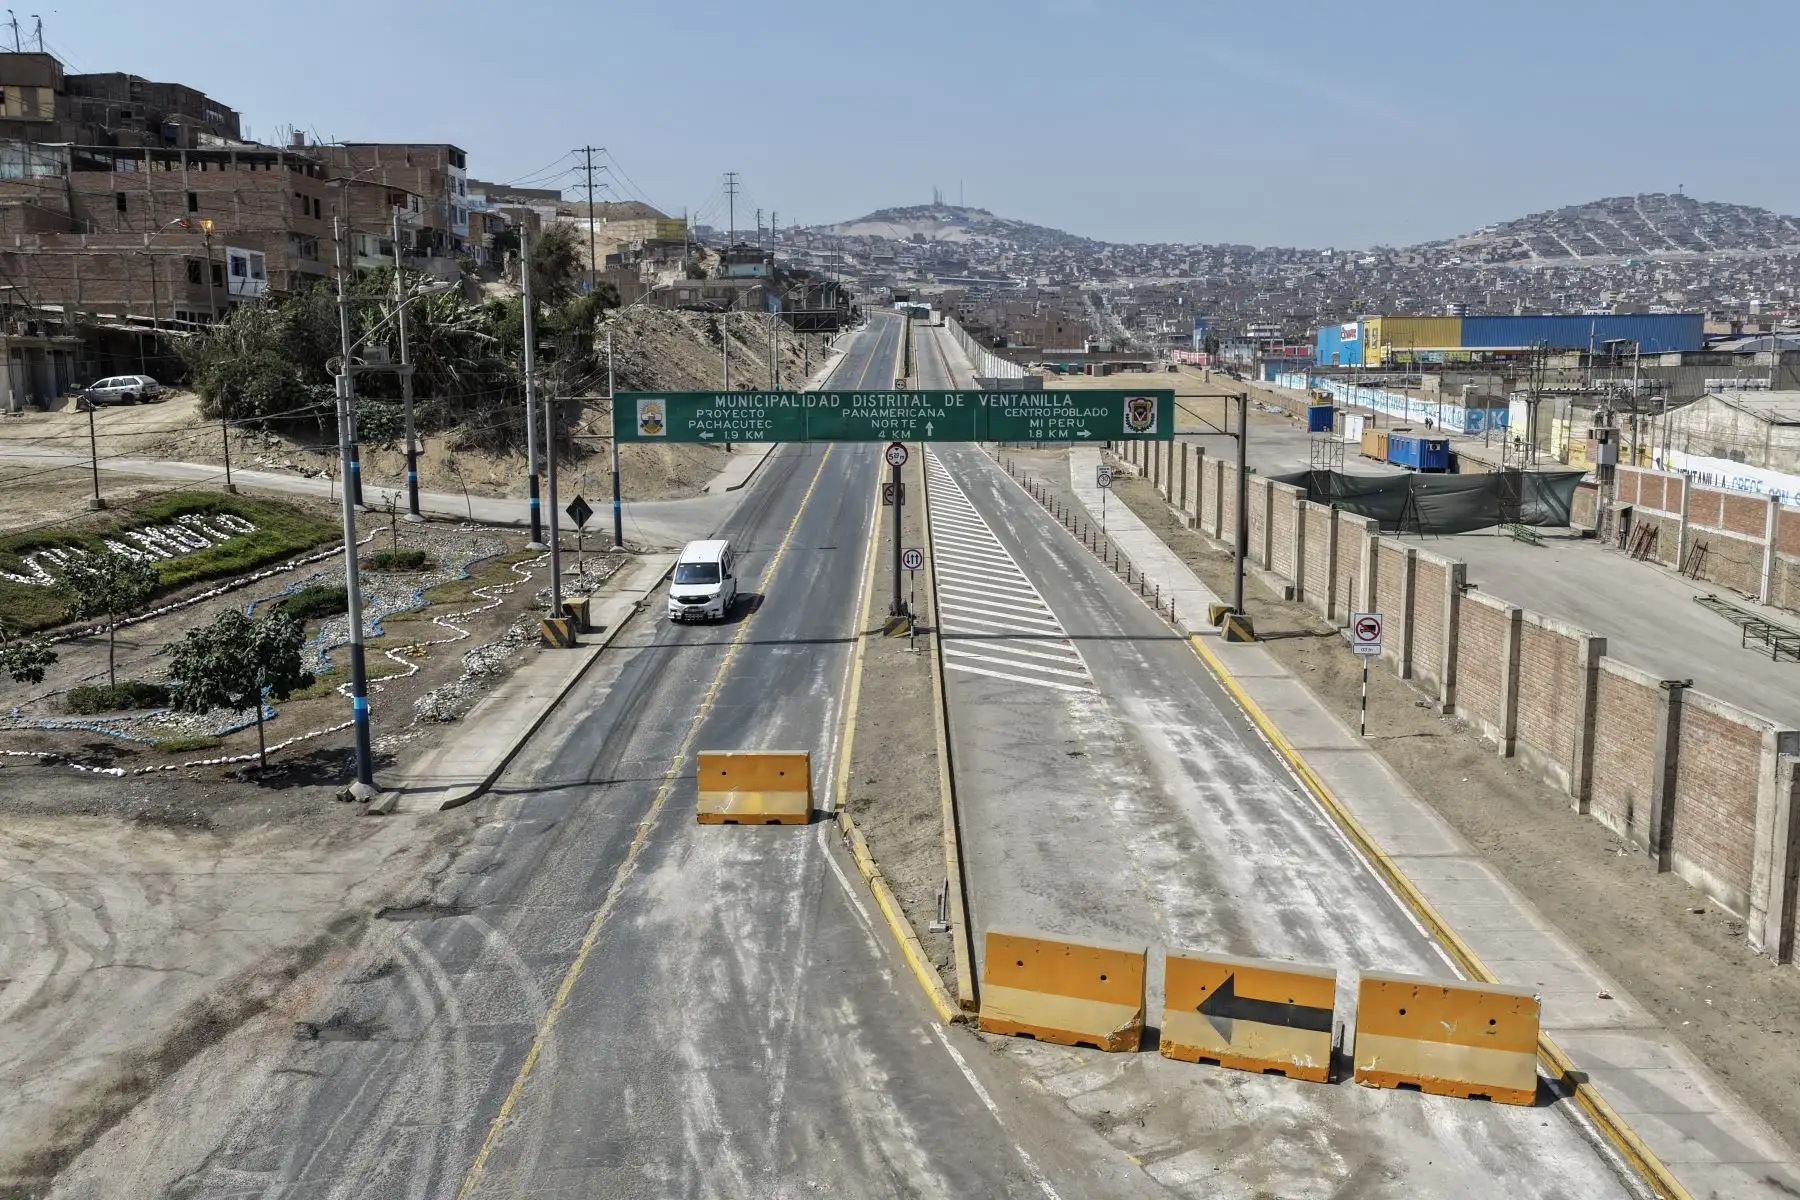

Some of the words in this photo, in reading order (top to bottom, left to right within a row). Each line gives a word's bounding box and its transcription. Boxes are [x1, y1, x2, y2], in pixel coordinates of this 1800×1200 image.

[715, 395, 840, 407] MUNICIPALIDAD
[853, 394, 931, 407] DISTRITAL
[945, 394, 964, 407] DE
[978, 394, 1073, 407] VENTANILLA
[696, 409, 765, 418] PROYECTO
[842, 409, 945, 418] PANAMERICANA
[1004, 408, 1051, 417] CENTRO
[1053, 408, 1108, 417] POBLADO
[688, 420, 773, 429] PACHACUTEC
[871, 420, 917, 428] NORTE
[1029, 419, 1044, 428] MI
[1049, 419, 1085, 428] PERU
[723, 431, 739, 440] 1.9
[745, 431, 764, 440] KM
[878, 430, 886, 439] 4
[892, 430, 911, 439] KM
[1028, 430, 1043, 438] 1.8
[1049, 429, 1068, 438] KM
